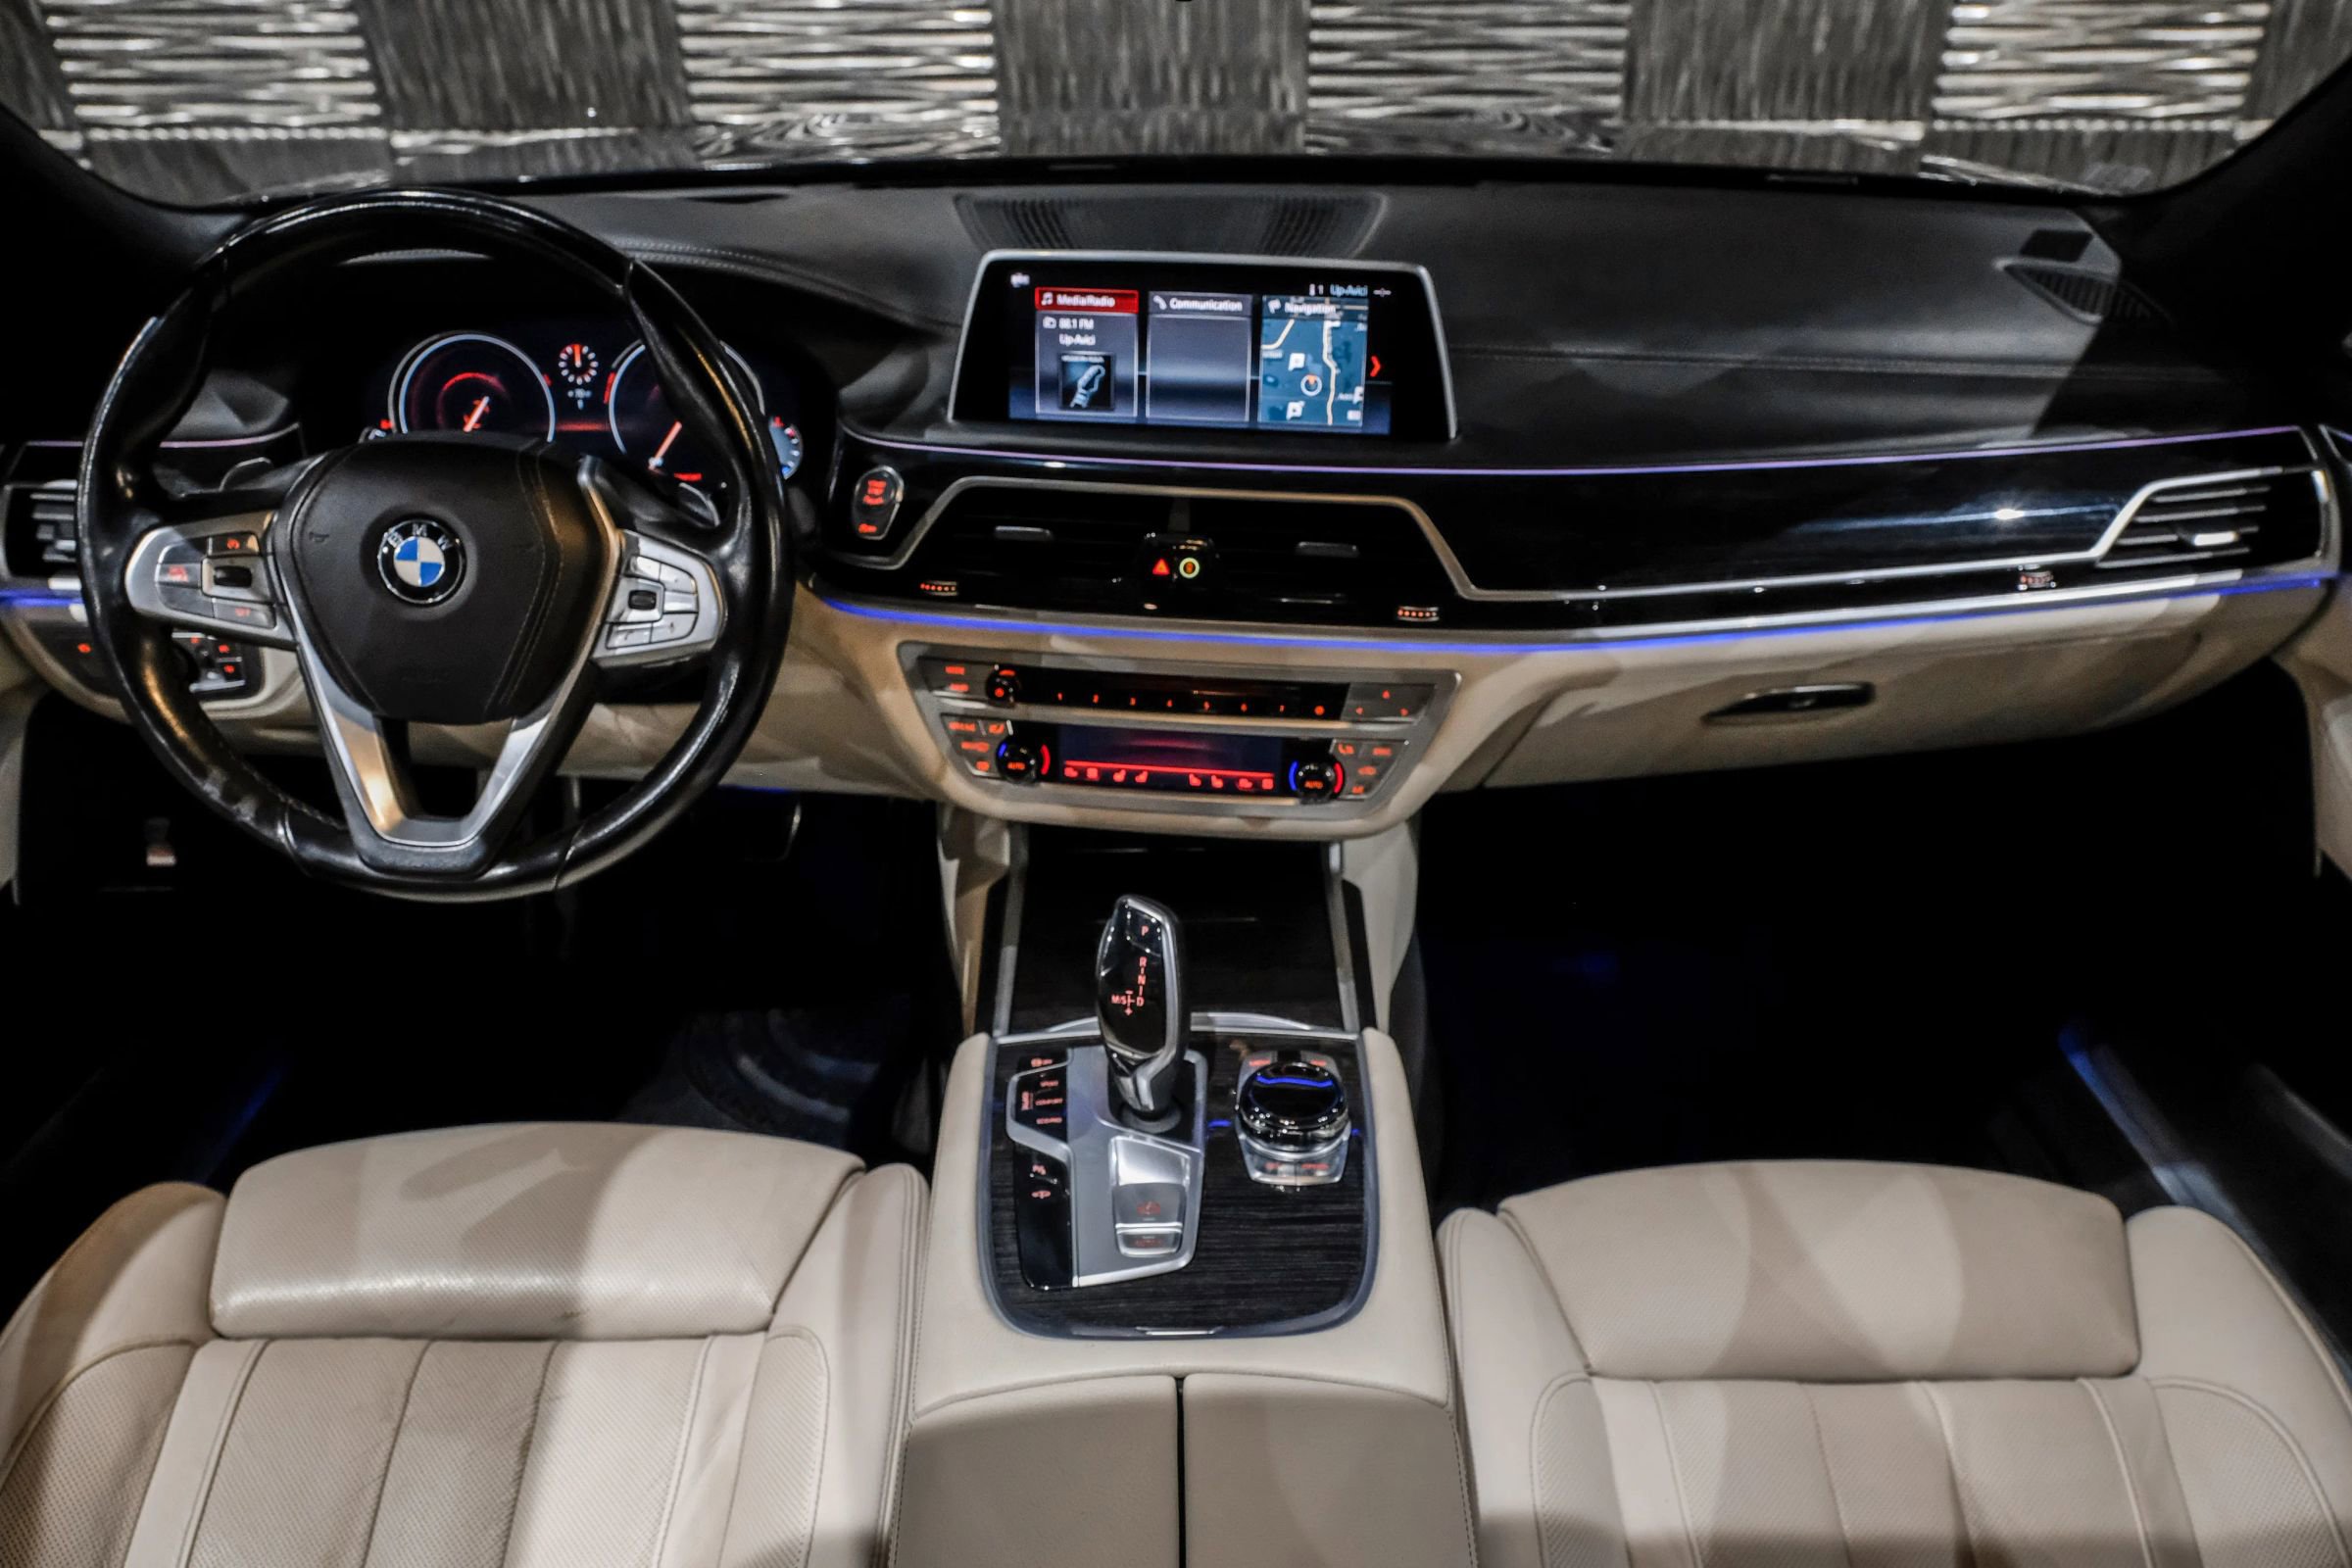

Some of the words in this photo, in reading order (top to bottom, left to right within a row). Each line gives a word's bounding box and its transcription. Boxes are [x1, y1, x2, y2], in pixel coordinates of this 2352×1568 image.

[1169, 297, 1243, 312] Communication
[1284, 301, 1337, 316] Navigation
[387, 523, 453, 551] BMW
[1141, 925, 1150, 937] P
[1139, 956, 1148, 967] R
